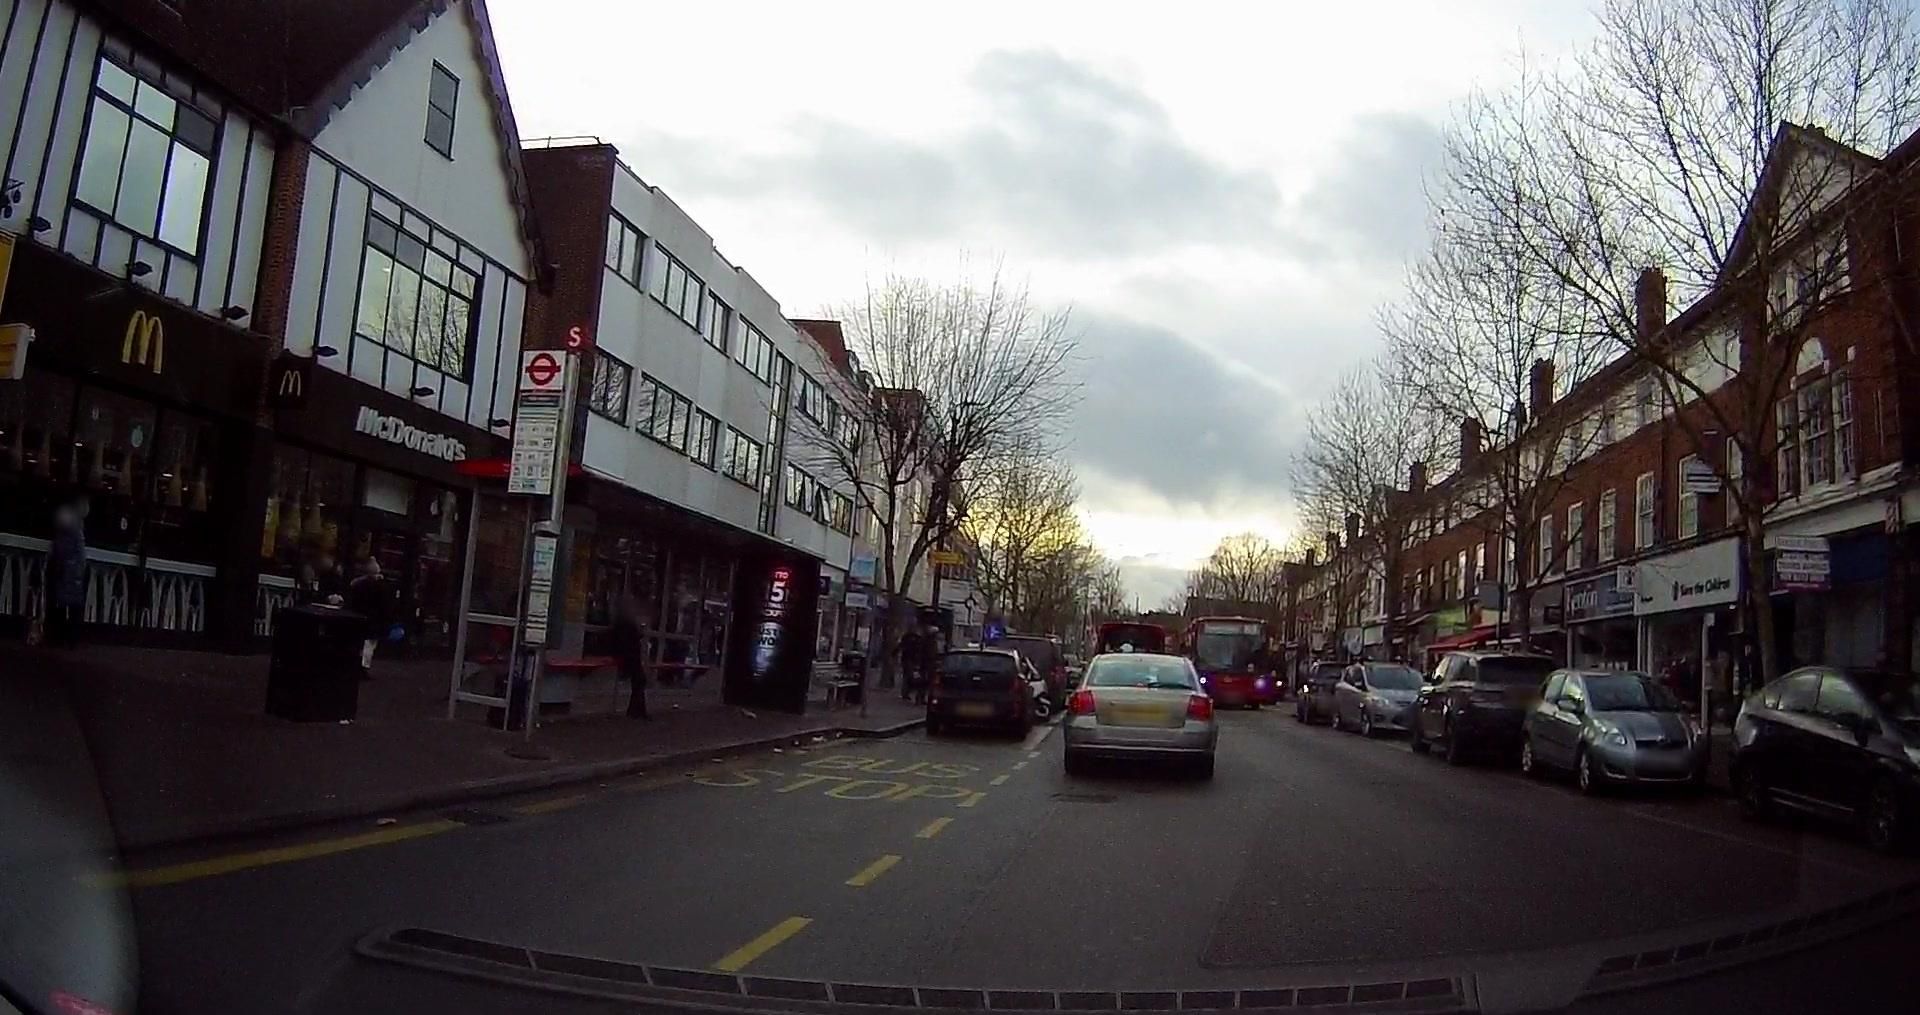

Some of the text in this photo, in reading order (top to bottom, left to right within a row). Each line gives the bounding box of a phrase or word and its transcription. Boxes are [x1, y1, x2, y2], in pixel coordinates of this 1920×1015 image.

[568, 327, 581, 347] S
[355, 405, 466, 462] McDonald's
[770, 581, 786, 602] 5
[801, 755, 979, 778] BUS
[693, 769, 974, 800] STOP
